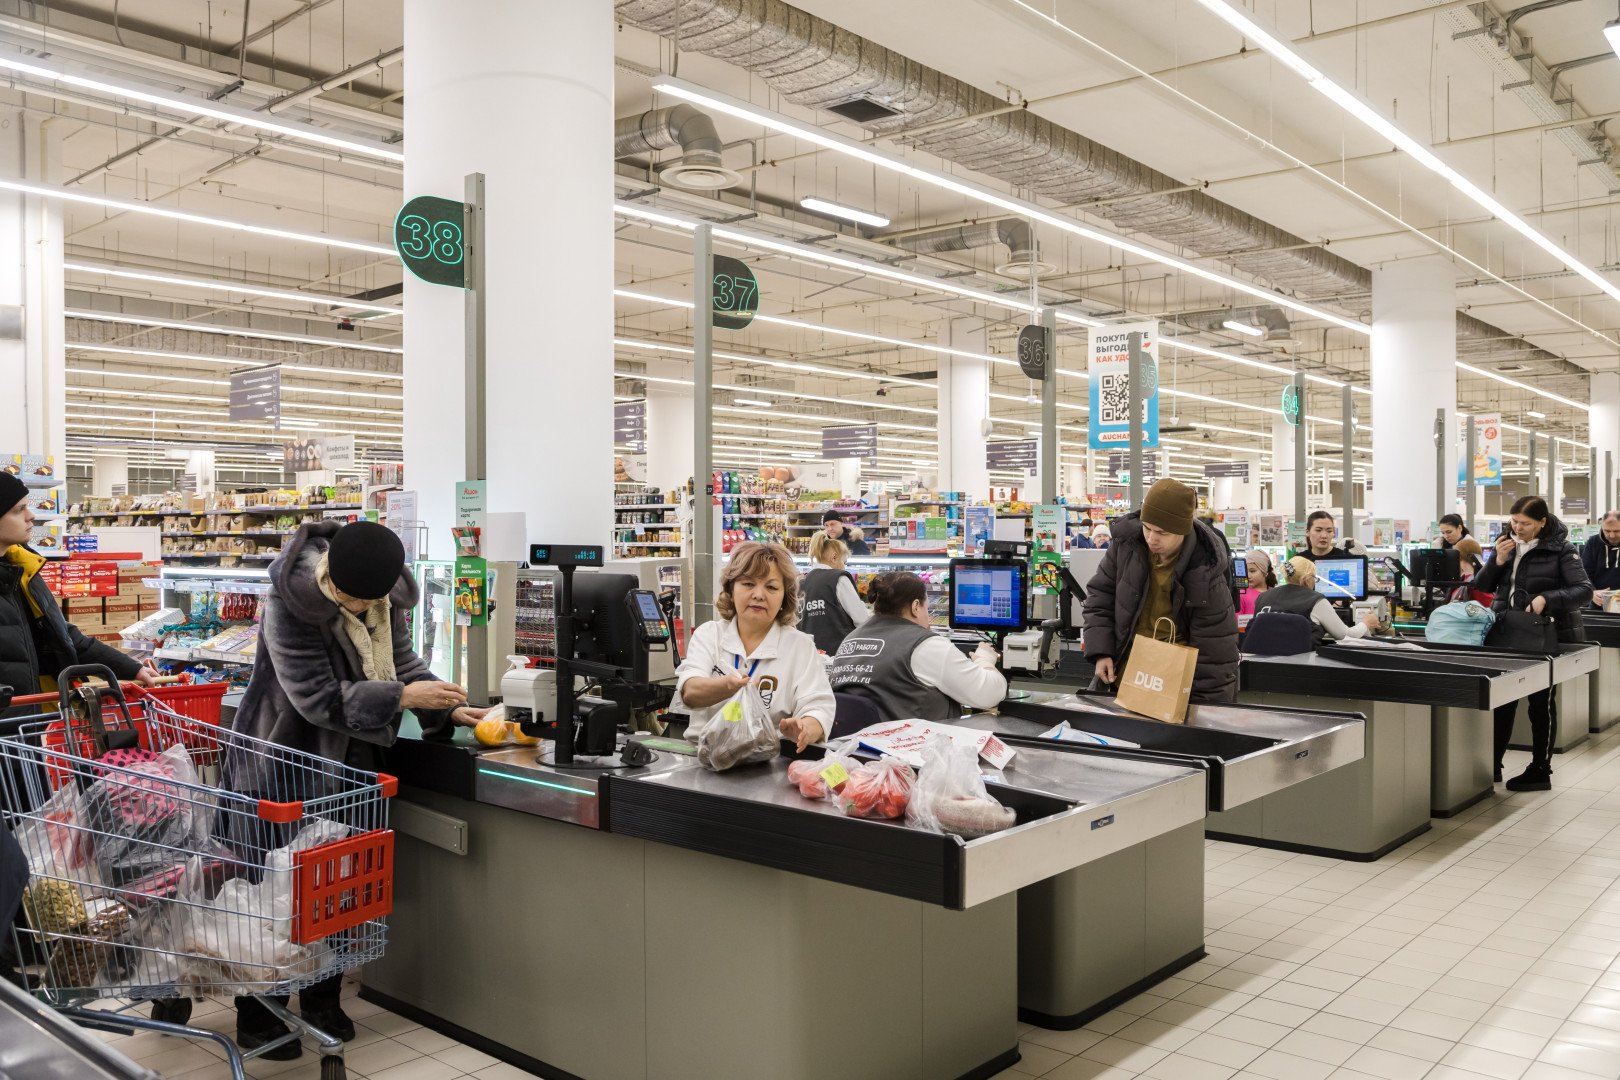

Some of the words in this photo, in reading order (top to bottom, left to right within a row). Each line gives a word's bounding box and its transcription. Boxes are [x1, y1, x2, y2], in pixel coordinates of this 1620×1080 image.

[401, 214, 463, 264] 38
[713, 273, 756, 313] 37
[1019, 337, 1045, 366] 36
[1096, 344, 1129, 353] ВЫГОД
[1096, 355, 1112, 363] КАК
[1283, 393, 1299, 416] 34
[326, 445, 346, 453] Конфеты
[329, 453, 350, 461] шоколад
[806, 599, 825, 611] GSR
[855, 643, 878, 651] РАБОТА
[1134, 670, 1164, 692] DUB
